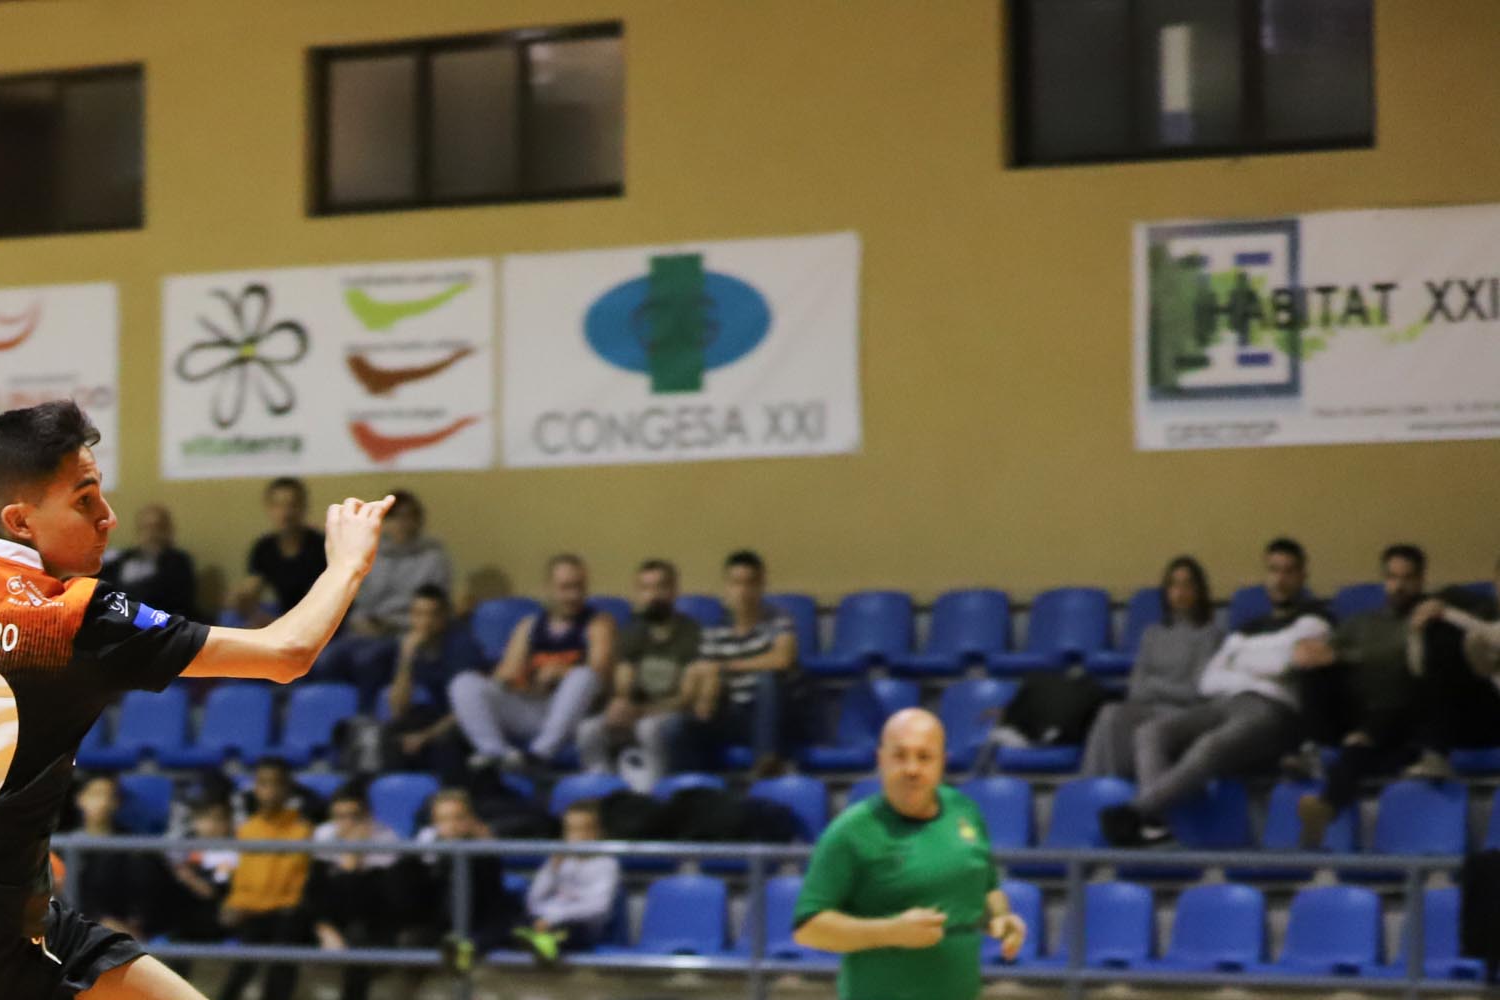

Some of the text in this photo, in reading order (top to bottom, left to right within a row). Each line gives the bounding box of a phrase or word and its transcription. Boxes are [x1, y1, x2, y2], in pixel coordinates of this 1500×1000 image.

[1194, 280, 1398, 334] HABITAT
[531, 400, 827, 455] CONGESA XXI
